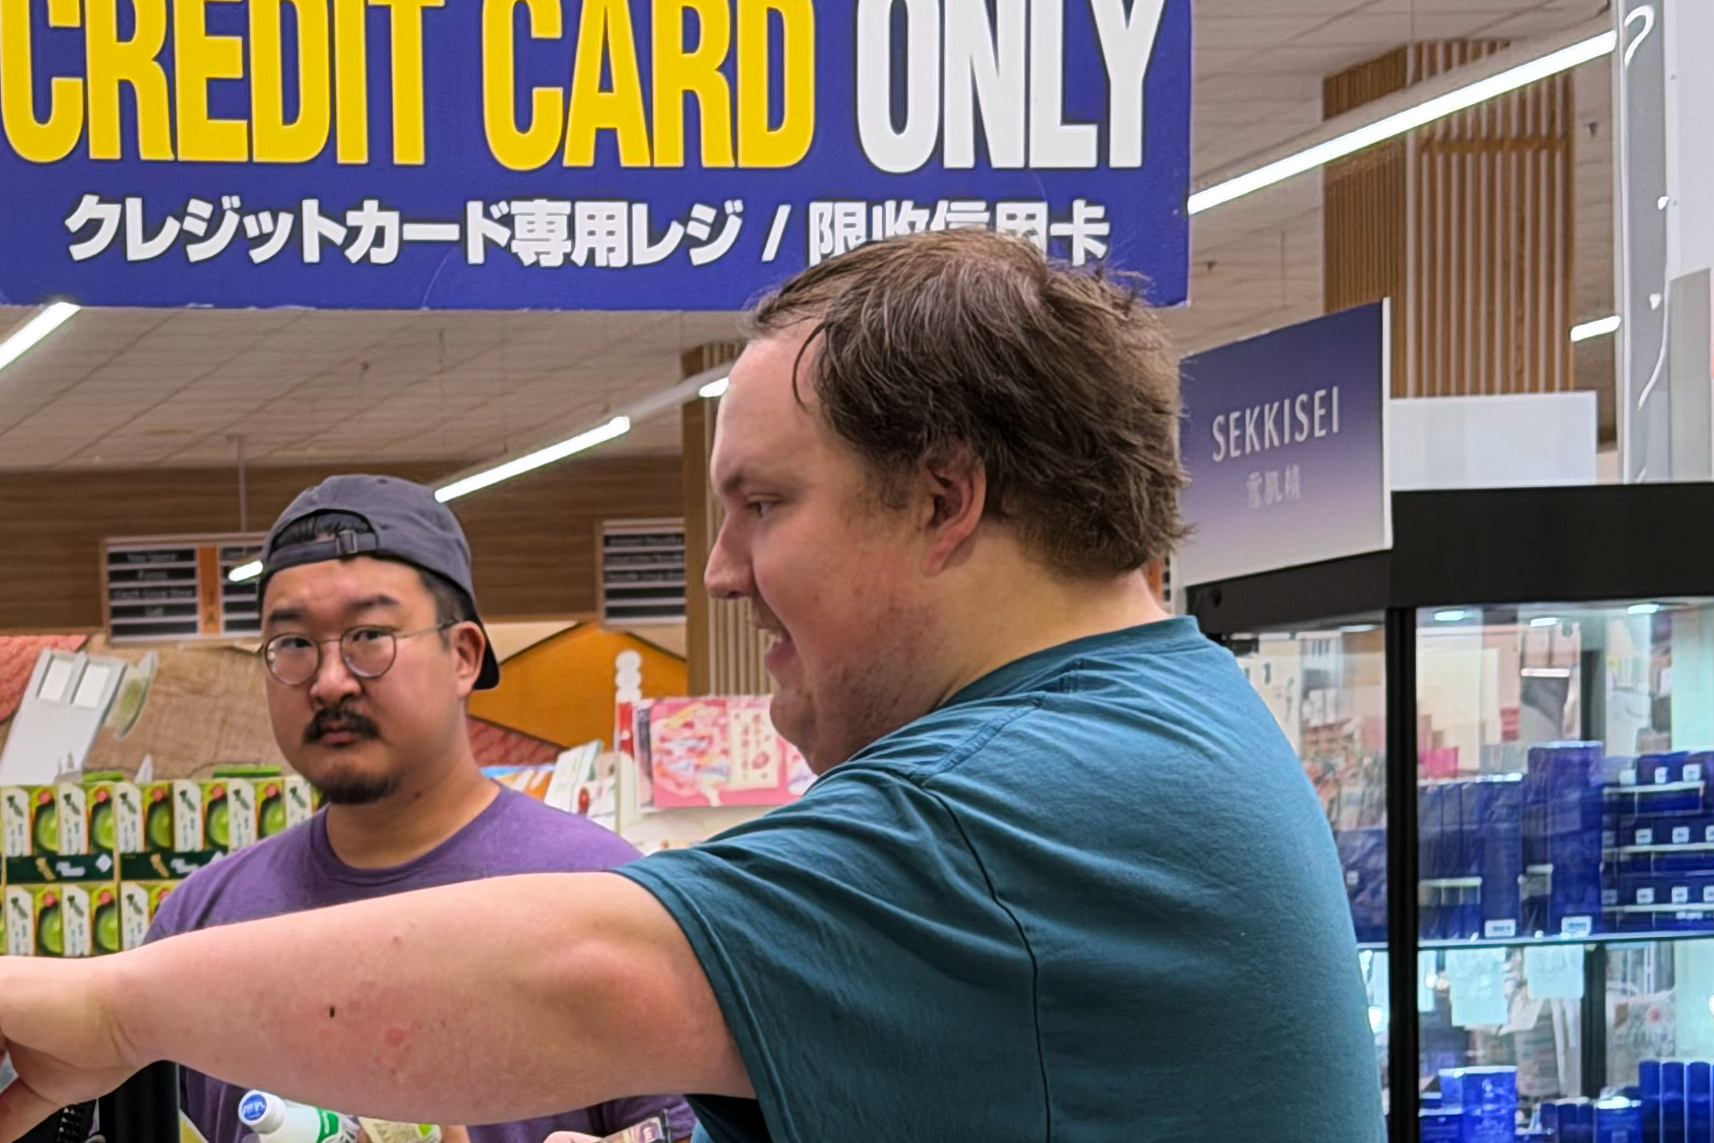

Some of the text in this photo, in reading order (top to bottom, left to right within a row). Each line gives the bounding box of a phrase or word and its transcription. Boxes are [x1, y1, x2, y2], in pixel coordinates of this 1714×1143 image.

[484, 0, 816, 171] CARD
[855, 0, 1168, 175] ONLY
[64, 193, 744, 266] クレジットカード専用レジ
[1212, 385, 1339, 462] SEKKISEI
